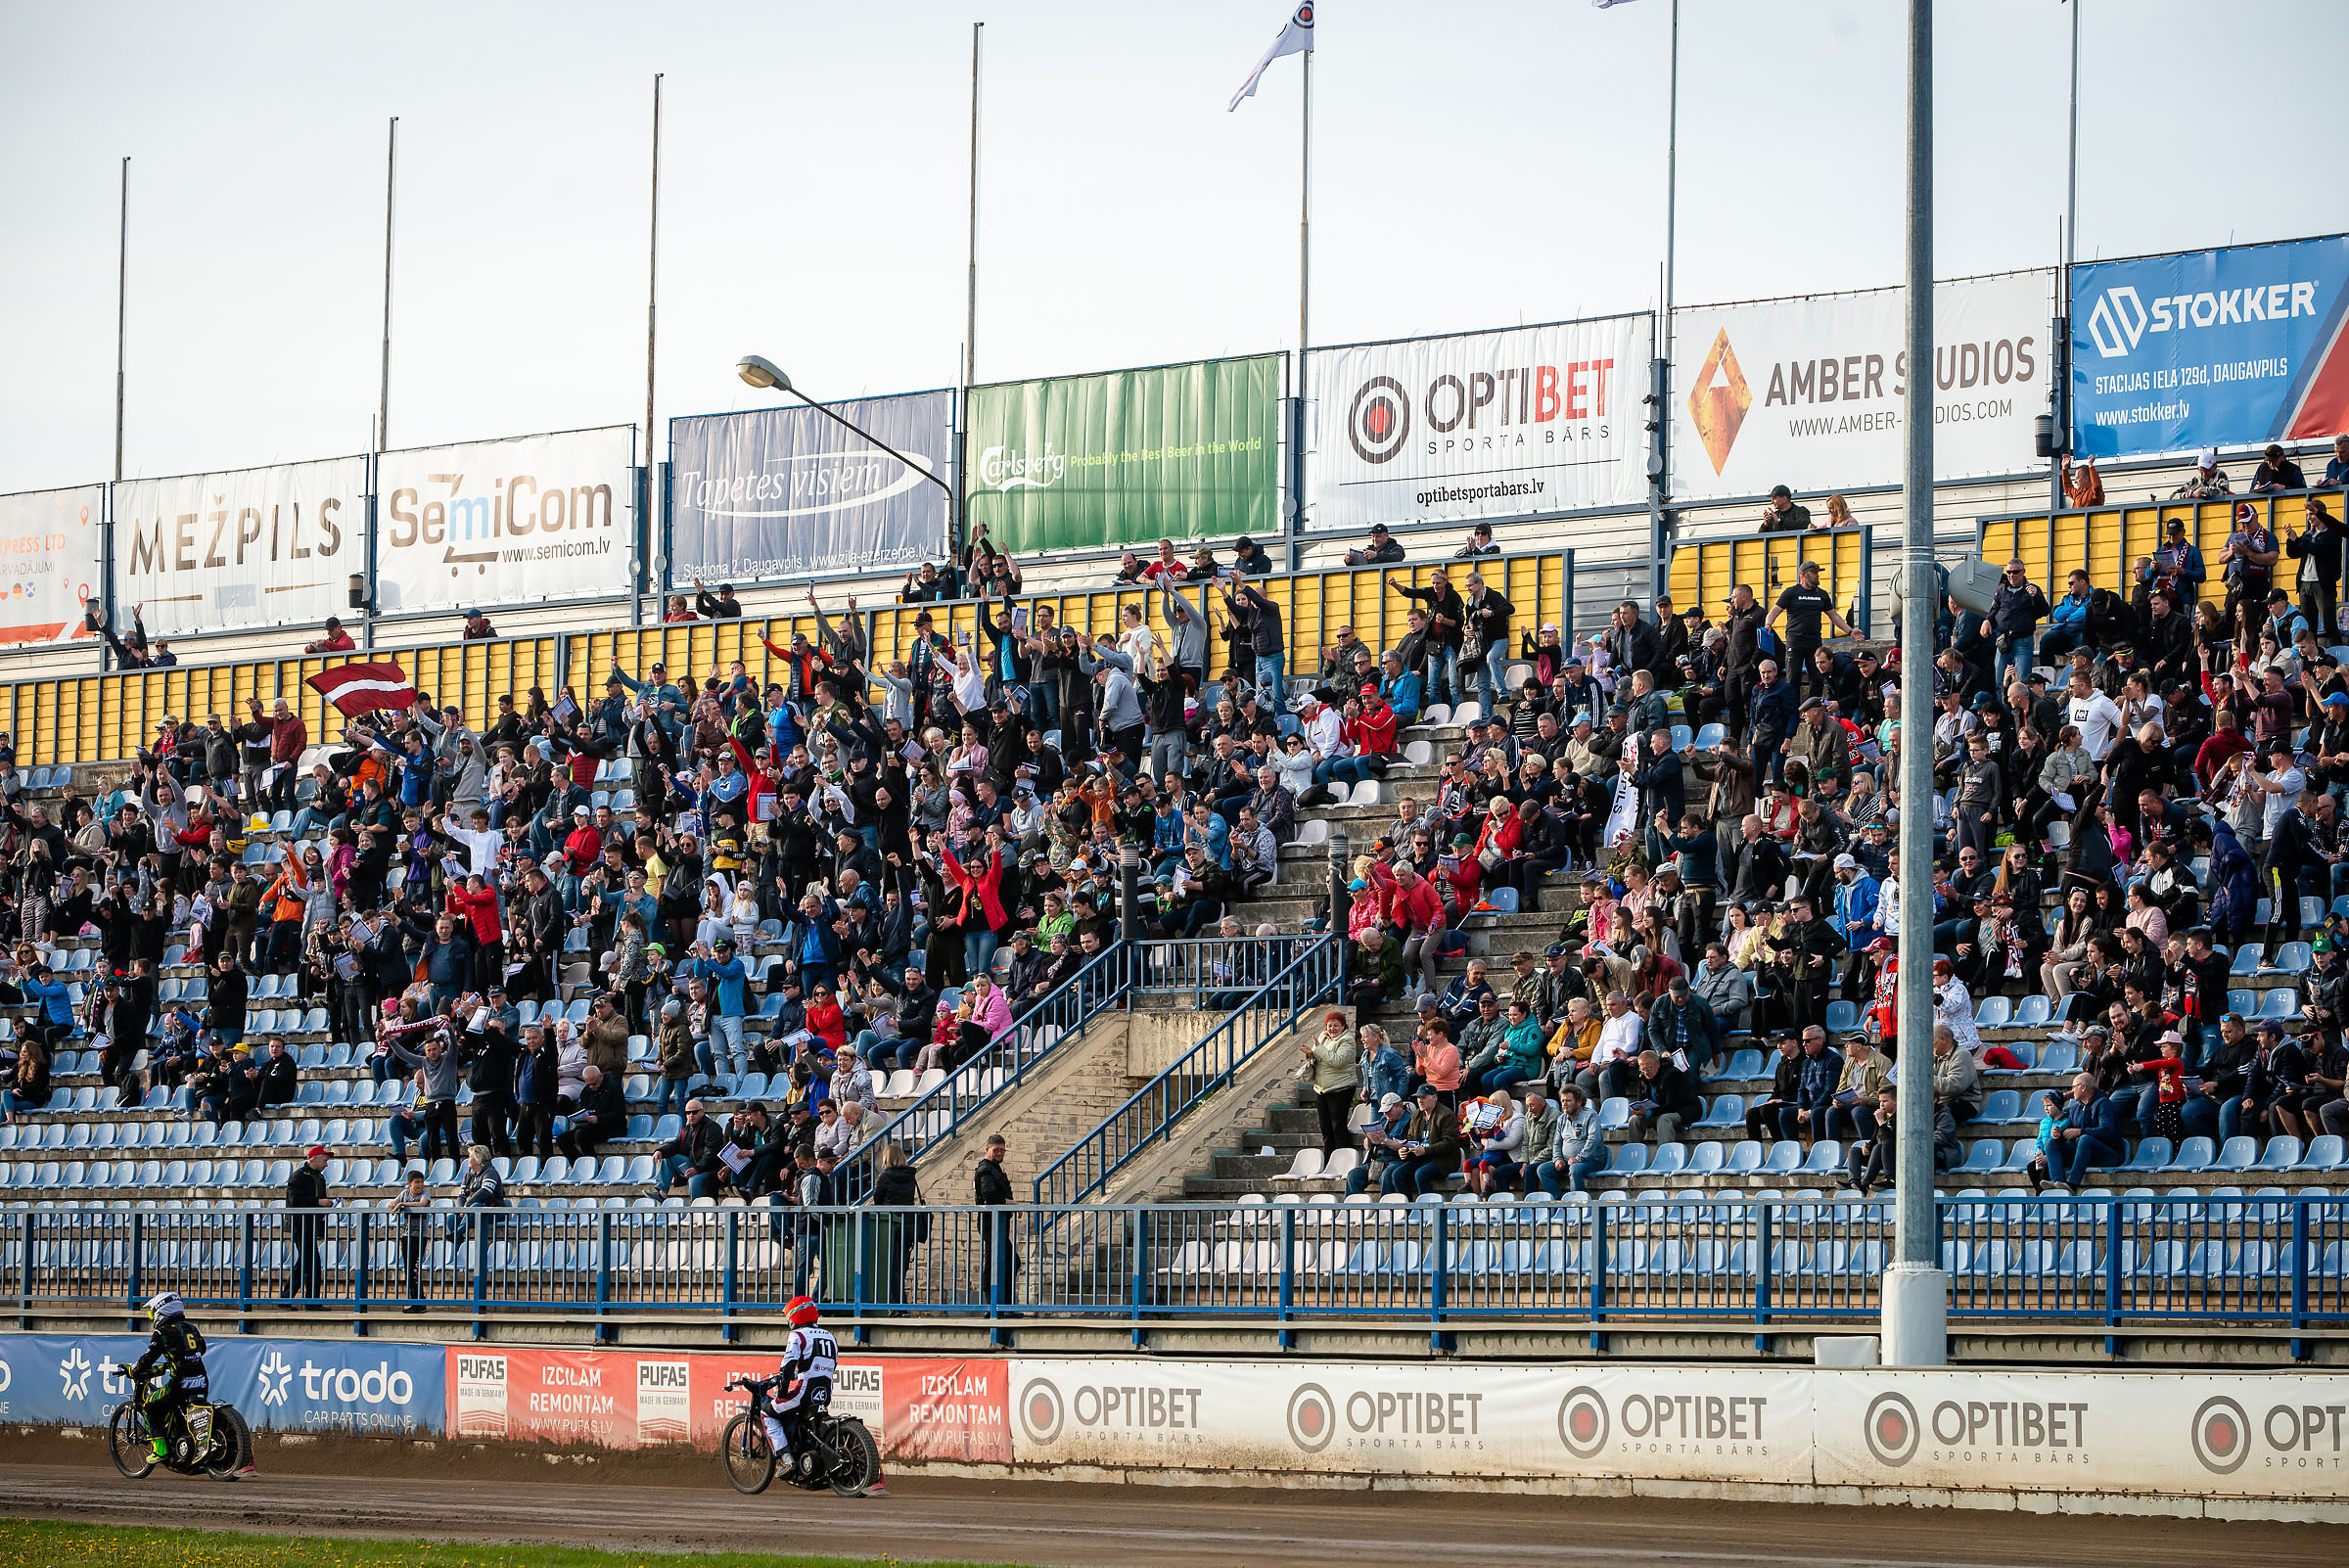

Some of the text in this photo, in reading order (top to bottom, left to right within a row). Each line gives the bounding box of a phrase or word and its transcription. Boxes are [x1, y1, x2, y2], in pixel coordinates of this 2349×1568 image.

[2149, 281, 2316, 333] STOKKER
[1765, 336, 2035, 407] AMBER SUDIOS
[2096, 358, 2287, 394] STACIJAS IELA 129d, DAUGAVPILS
[1425, 358, 1614, 433] OPTIBET
[1789, 398, 2012, 438] WWW.AMBER-DIOS.COM
[2096, 399, 2189, 426] www.stokker.lv
[1428, 424, 1609, 455] SPORTA BĀRS
[1070, 437, 1263, 468] Probably the Best Beer in the World
[980, 442, 1066, 493] Carlsberg
[682, 461, 881, 520] Tapetes visiem
[1416, 479, 1544, 508] optibetsportabars.lv
[391, 475, 612, 548] SemiCom
[45, 534, 66, 551] LTD
[129, 493, 342, 576] MEŽPILS
[502, 536, 611, 564] www.semicom.lv
[683, 562, 729, 578] Stadiona
[744, 555, 803, 575] Daugavpils
[809, 545, 929, 568] www.zila-ezerzeme.lv
[2033, 1000, 2042, 1009] 16
[186, 1333, 197, 1349] 6
[819, 1340, 832, 1358] 11
[460, 1359, 504, 1380] PUFAS
[542, 1365, 601, 1387] IZCILAM
[640, 1365, 686, 1386] PUFAS
[299, 1360, 413, 1405] trodo
[832, 1370, 880, 1392] PUFAS
[922, 1375, 988, 1397] IZCILAM
[460, 1388, 474, 1397] MADE
[482, 1389, 505, 1399] GERMANY
[530, 1393, 614, 1414] REMONTAM
[640, 1396, 654, 1405] MADE
[663, 1397, 687, 1407] GERMANY
[848, 1402, 853, 1410] IN
[854, 1402, 880, 1410] GERMANY
[909, 1404, 1001, 1425] REMONTAM
[1074, 1385, 1202, 1428] OPTIBET
[1346, 1391, 1482, 1434] OPTIBET
[1621, 1394, 1767, 1440] OPTIBET
[304, 1410, 329, 1423] CAR
[331, 1411, 367, 1426] PARTS
[530, 1418, 614, 1434] WWW.PUFAS.LV
[1932, 1400, 2089, 1447] OPTIBET
[911, 1430, 1001, 1446] WWW.PUFAS.LV
[1075, 1429, 1203, 1444] SPORTA BĀRS
[1347, 1437, 1484, 1451] SPORTA BĀRS
[1622, 1442, 1768, 1455] SPORTA BĀRS
[1933, 1450, 2090, 1463] SPORTA BĀRS
